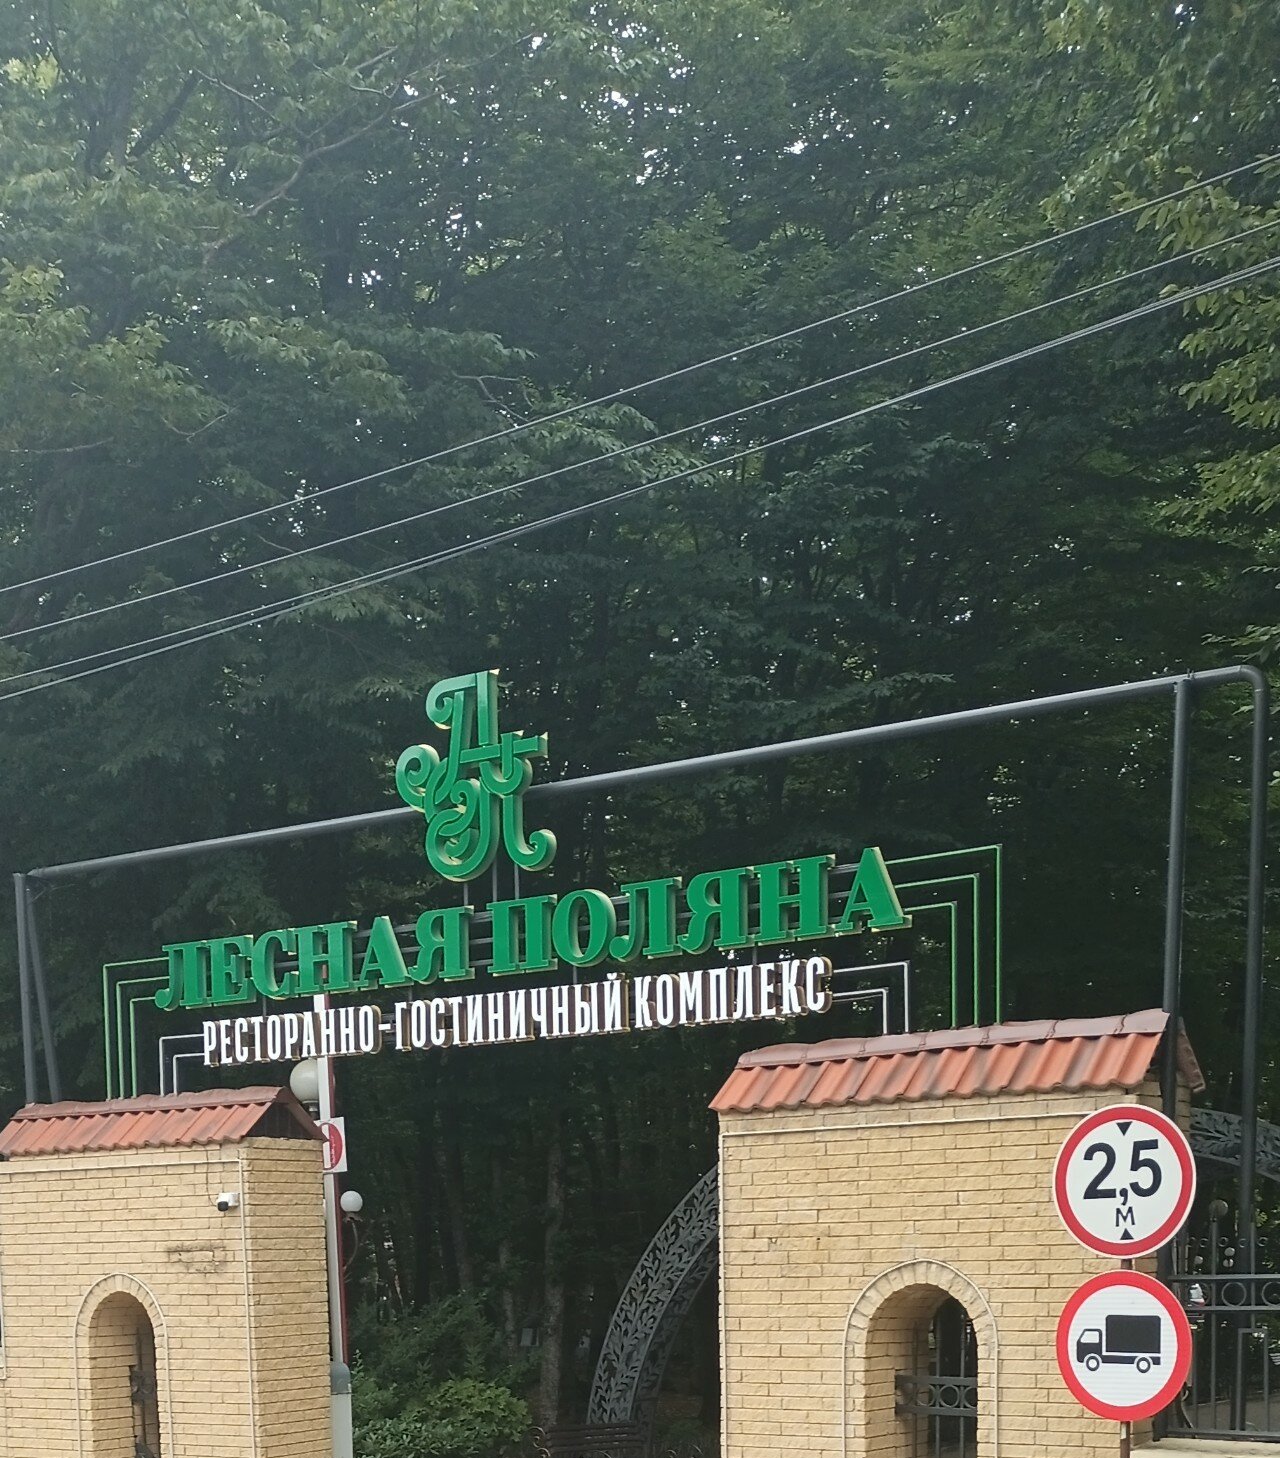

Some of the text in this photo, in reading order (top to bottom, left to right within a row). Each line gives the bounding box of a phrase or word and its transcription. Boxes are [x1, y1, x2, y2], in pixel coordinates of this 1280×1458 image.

[154, 846, 911, 1011] ЛЕСНАЯ ПОЛЯНА
[202, 956, 832, 1067] РЕСТОРАННО-ГОСТИНИЧНЫЙ КОМПЛЕКС
[1083, 1139, 1162, 1205] 2,5
